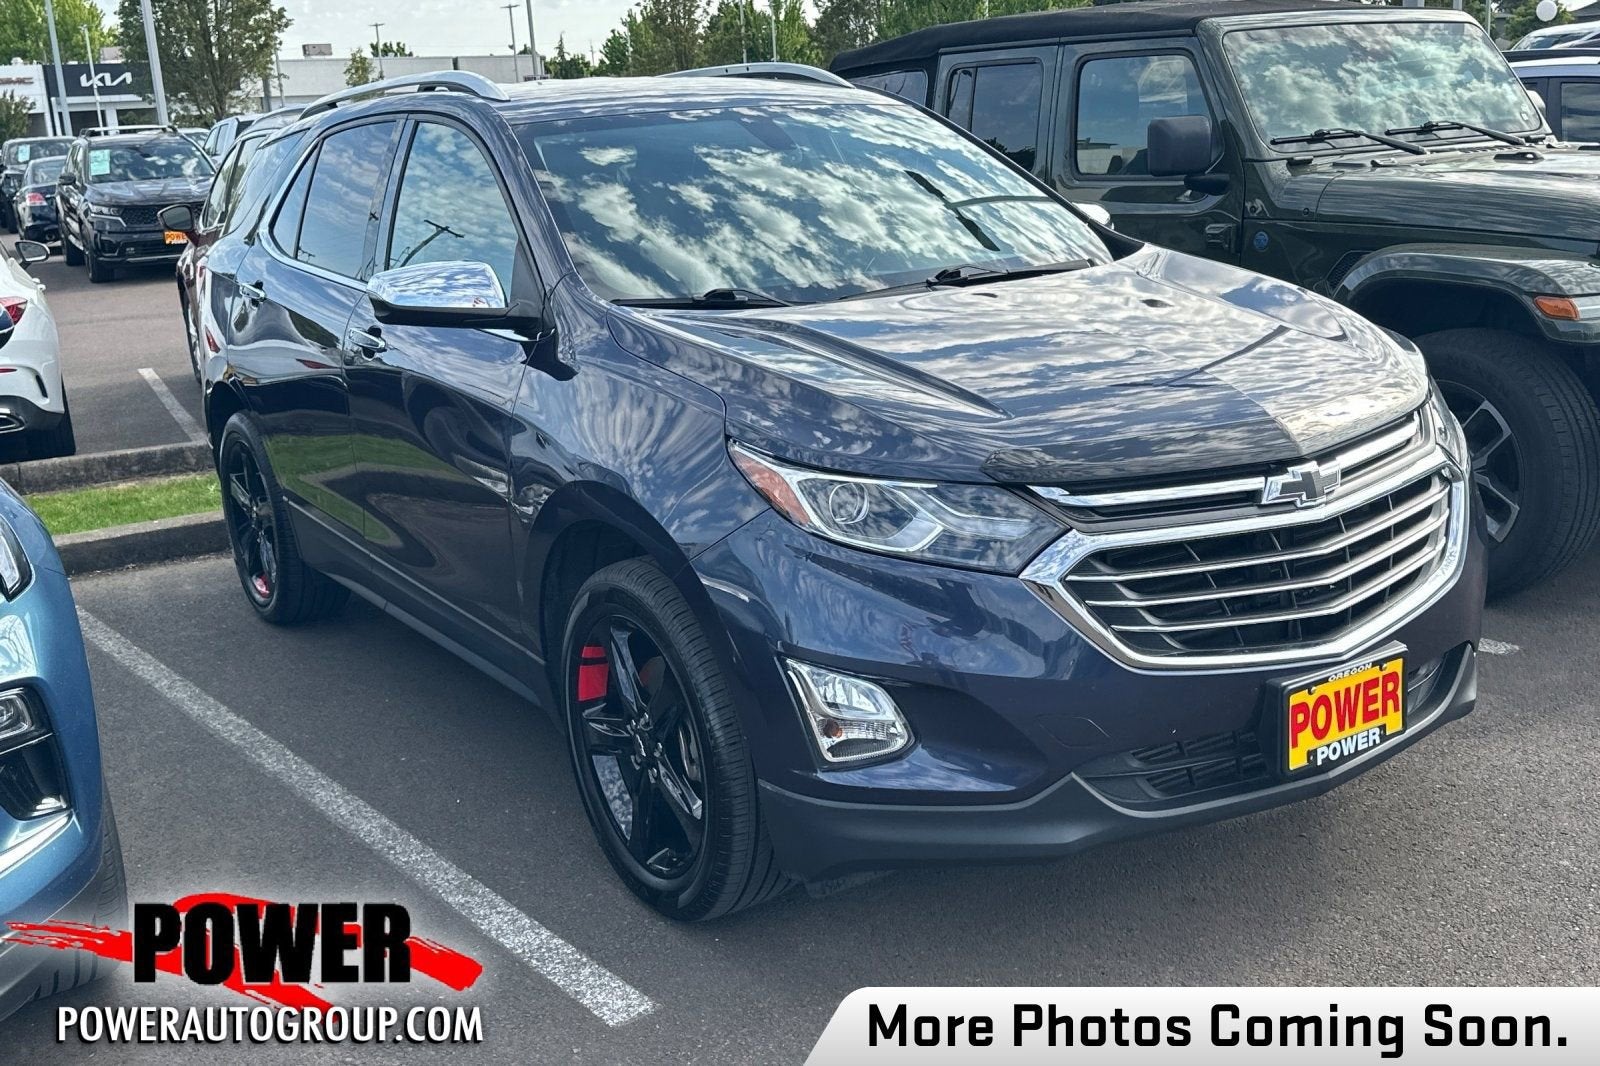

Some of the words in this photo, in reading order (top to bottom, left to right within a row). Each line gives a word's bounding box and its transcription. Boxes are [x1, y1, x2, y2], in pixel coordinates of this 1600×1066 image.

[1328, 663, 1372, 682] OREGON
[1290, 671, 1400, 748] POWER
[1317, 727, 1380, 765] POWER
